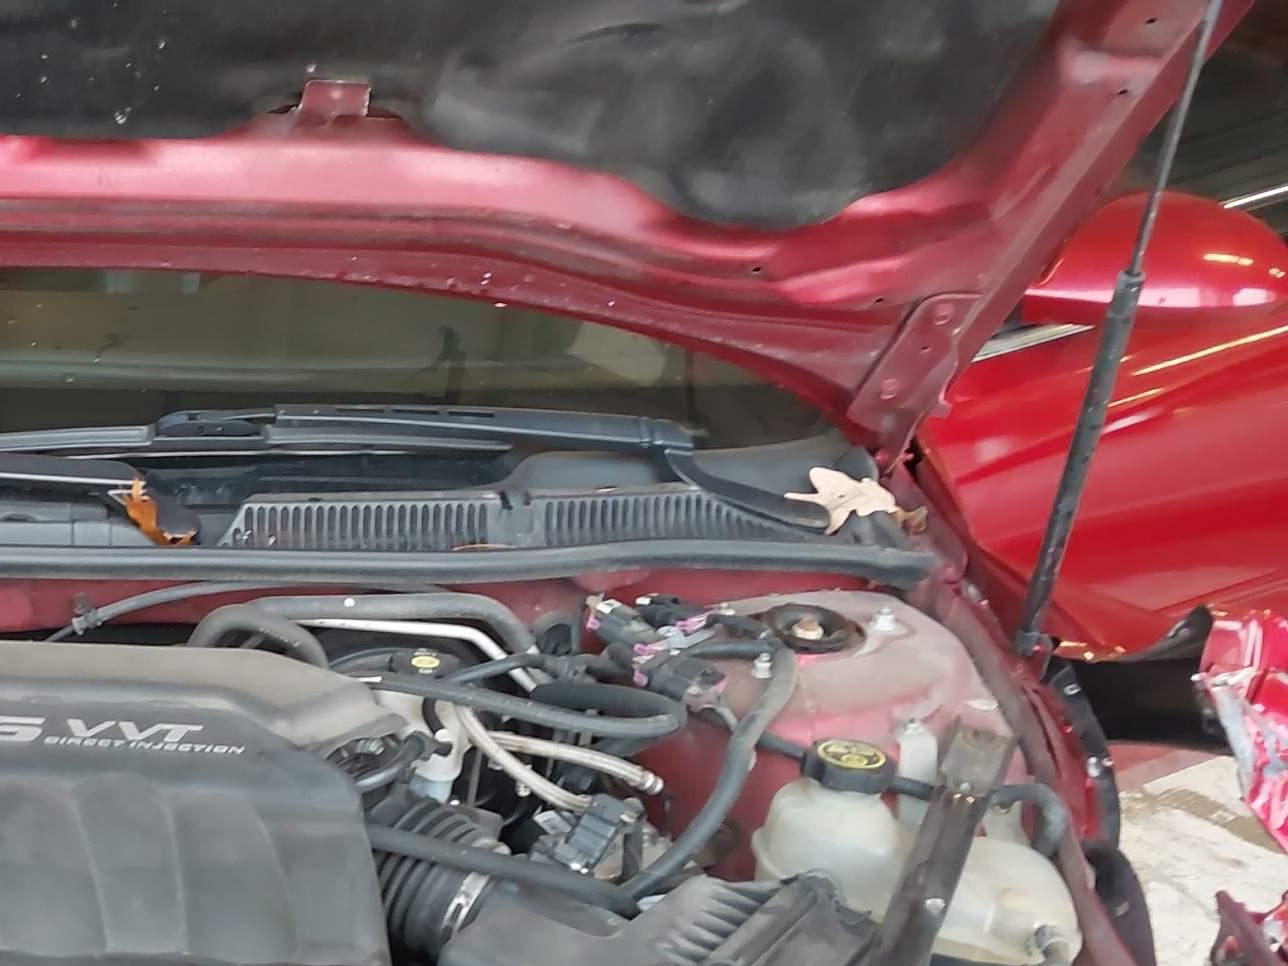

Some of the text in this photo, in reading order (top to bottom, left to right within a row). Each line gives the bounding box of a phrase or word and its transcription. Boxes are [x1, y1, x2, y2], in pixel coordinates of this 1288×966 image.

[66, 717, 205, 743] VVT
[43, 735, 246, 755] DIRECT INJECTION
